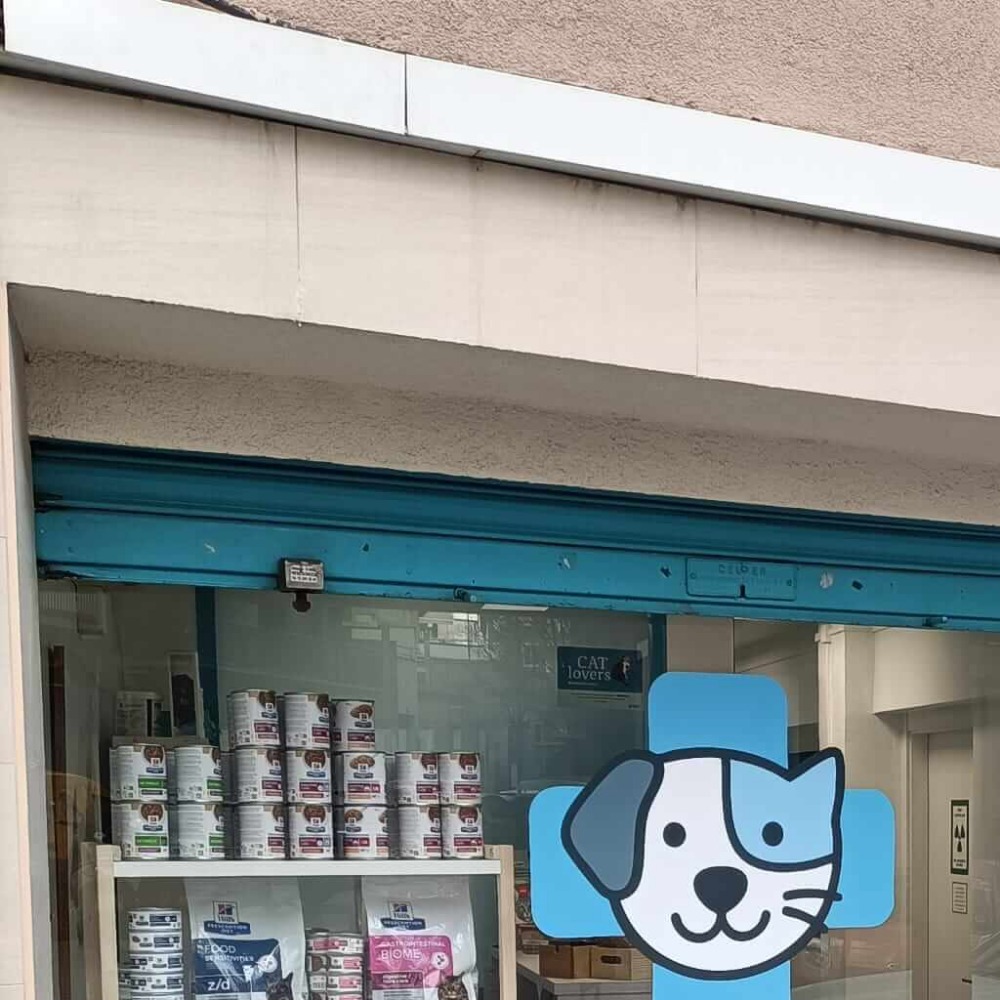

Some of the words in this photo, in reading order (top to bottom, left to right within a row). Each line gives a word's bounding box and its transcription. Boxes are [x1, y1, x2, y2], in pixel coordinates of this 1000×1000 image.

[577, 655, 609, 670] CAT
[568, 665, 611, 681] lovers
[204, 945, 237, 954] FOOD
[381, 949, 422, 960] BIOME
[207, 978, 231, 991] z/d
